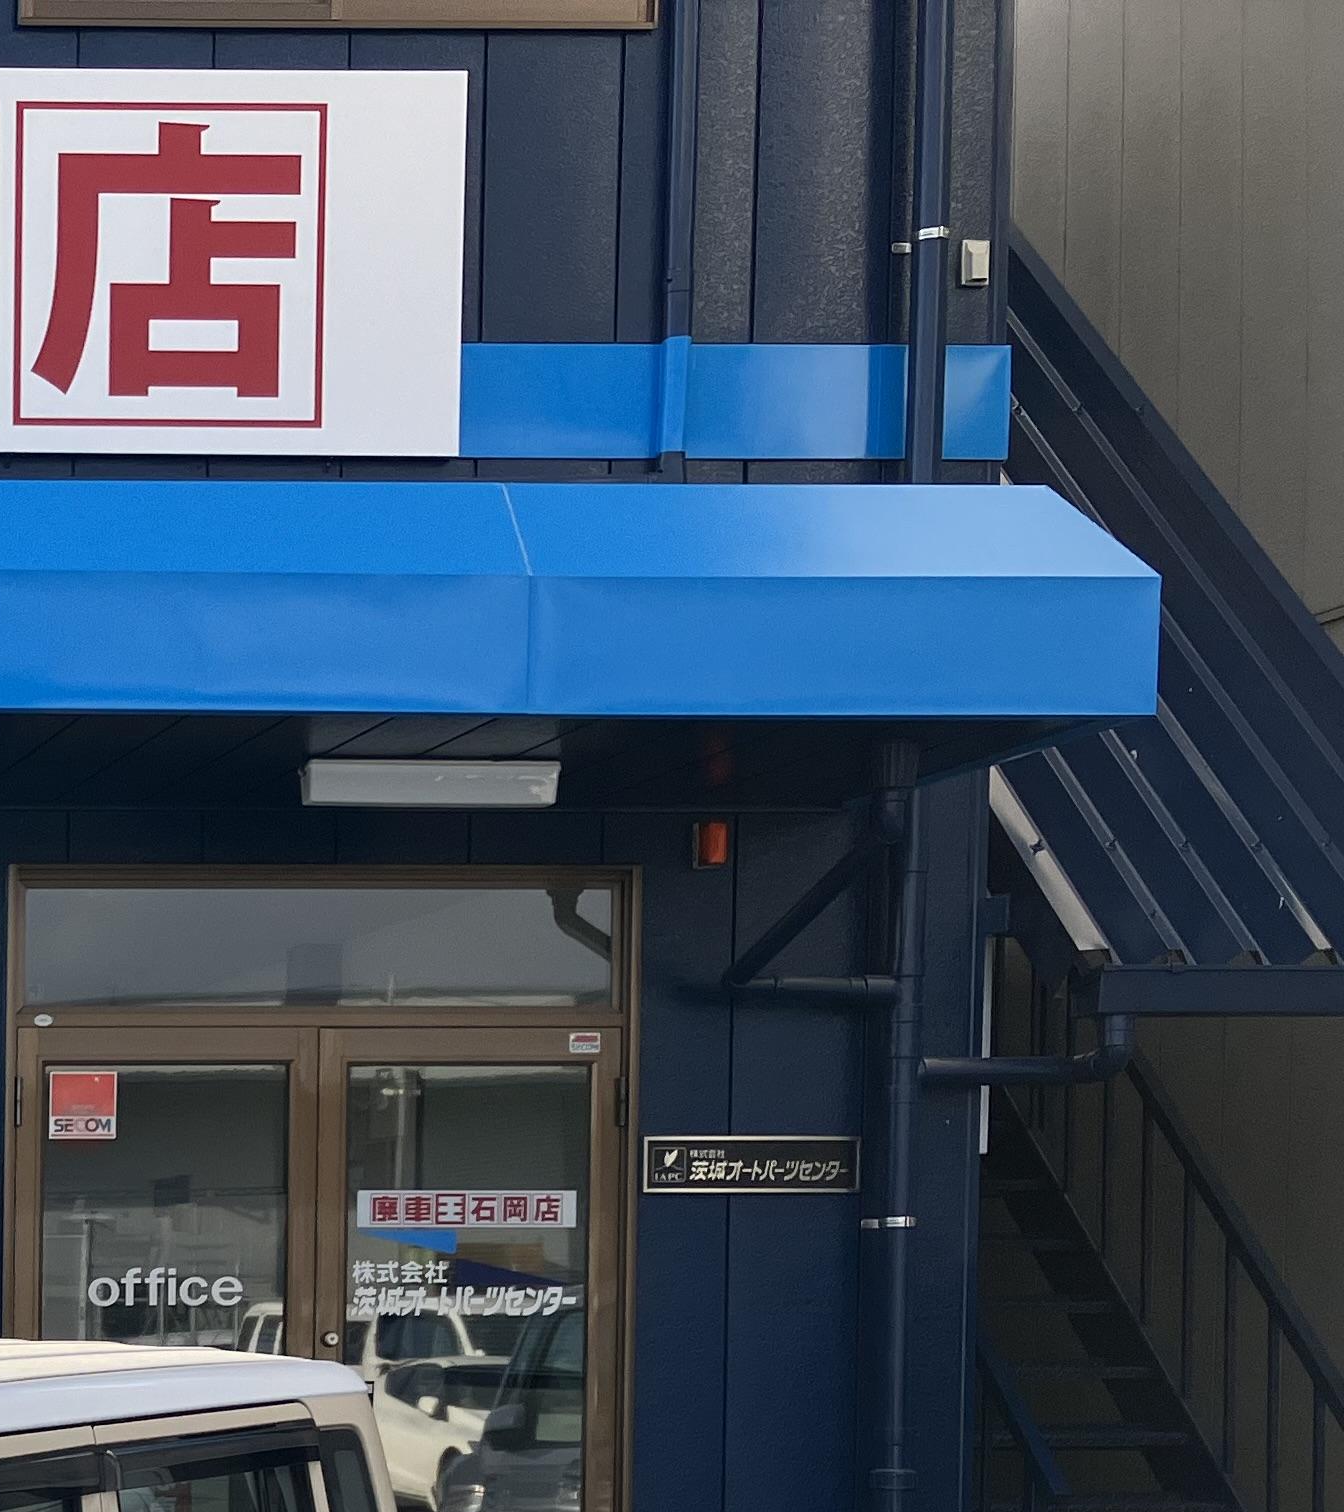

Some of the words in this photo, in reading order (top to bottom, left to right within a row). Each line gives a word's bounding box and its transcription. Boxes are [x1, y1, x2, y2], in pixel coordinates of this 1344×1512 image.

[689, 1159, 849, 1181] 茨城オートパーツセンター
[371, 1194, 561, 1224] 廃車王石岡店
[87, 1266, 244, 1307] office
[352, 1259, 451, 1284] 株式会社
[350, 1285, 577, 1317] 茨城オートパーツセンター
